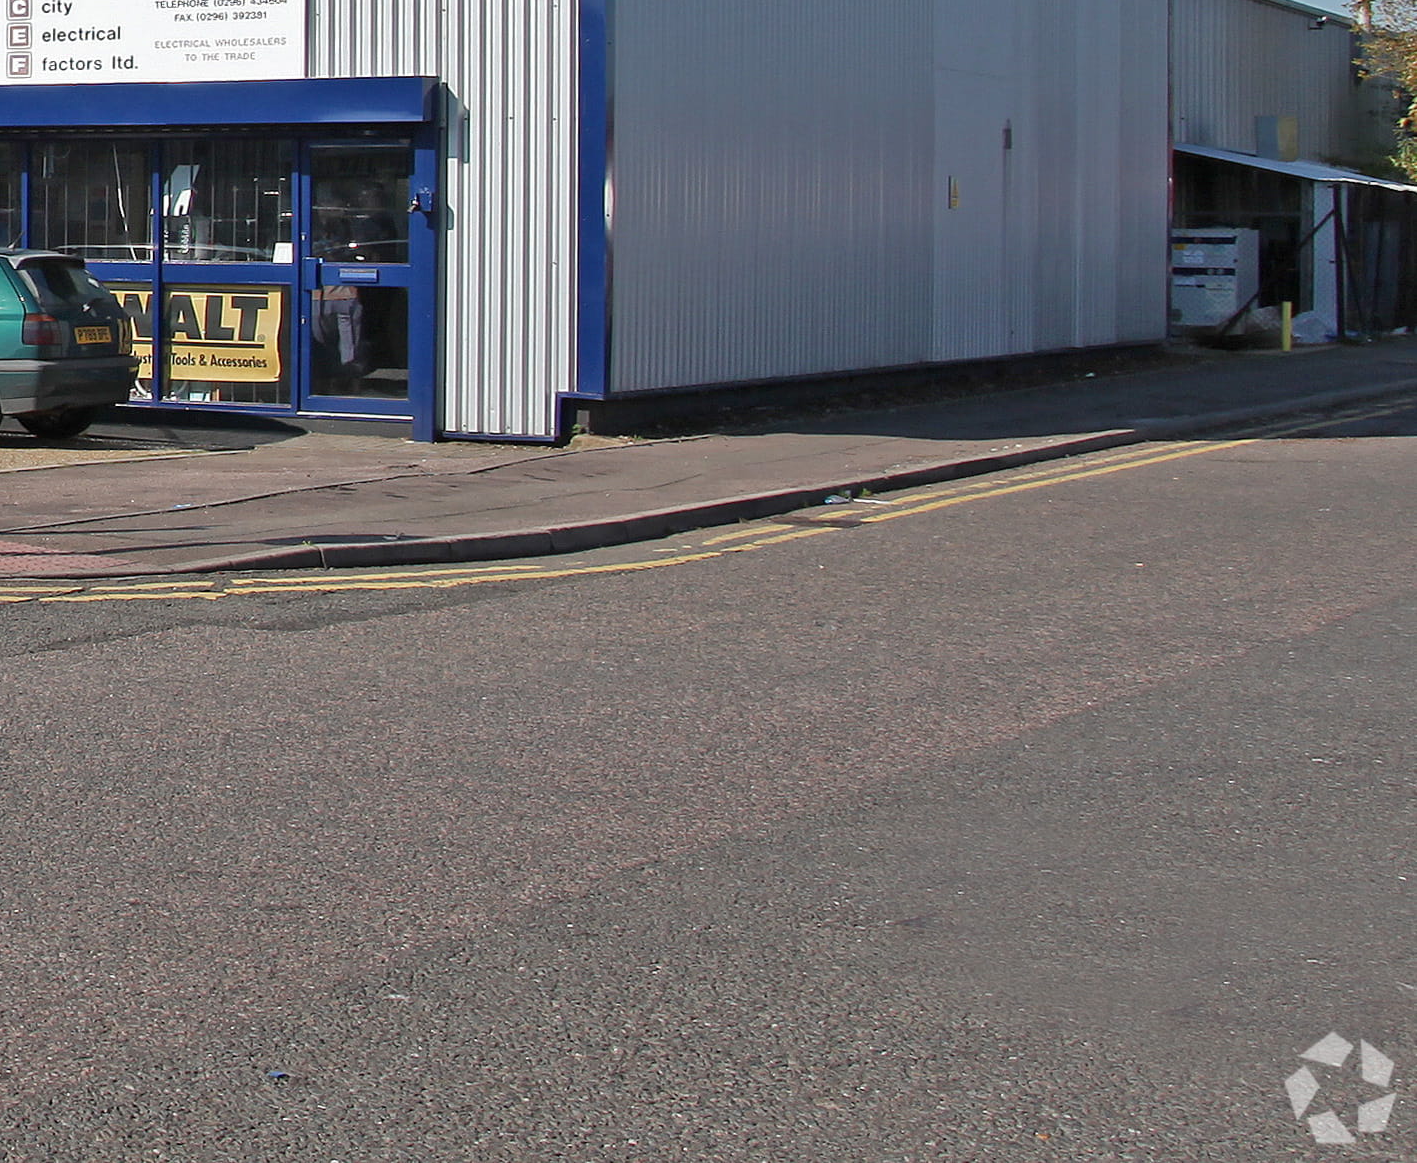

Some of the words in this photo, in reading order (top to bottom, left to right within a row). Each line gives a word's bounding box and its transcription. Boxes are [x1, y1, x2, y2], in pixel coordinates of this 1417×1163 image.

[41, 0, 73, 16] city
[155, 0, 209, 9] TELEPHONE
[196, 12, 228, 21] (0296)
[42, 25, 121, 42] electrical
[154, 39, 210, 49] ELECTRICAL
[215, 37, 287, 47] WHOLESALERS
[42, 56, 103, 72] factors
[112, 55, 139, 70] ltd.
[185, 53, 197, 62] TO
[202, 52, 220, 62] THE
[224, 51, 255, 61] TRADE
[171, 352, 196, 366] Tools
[199, 354, 207, 366] &
[210, 353, 268, 368] Accessories
